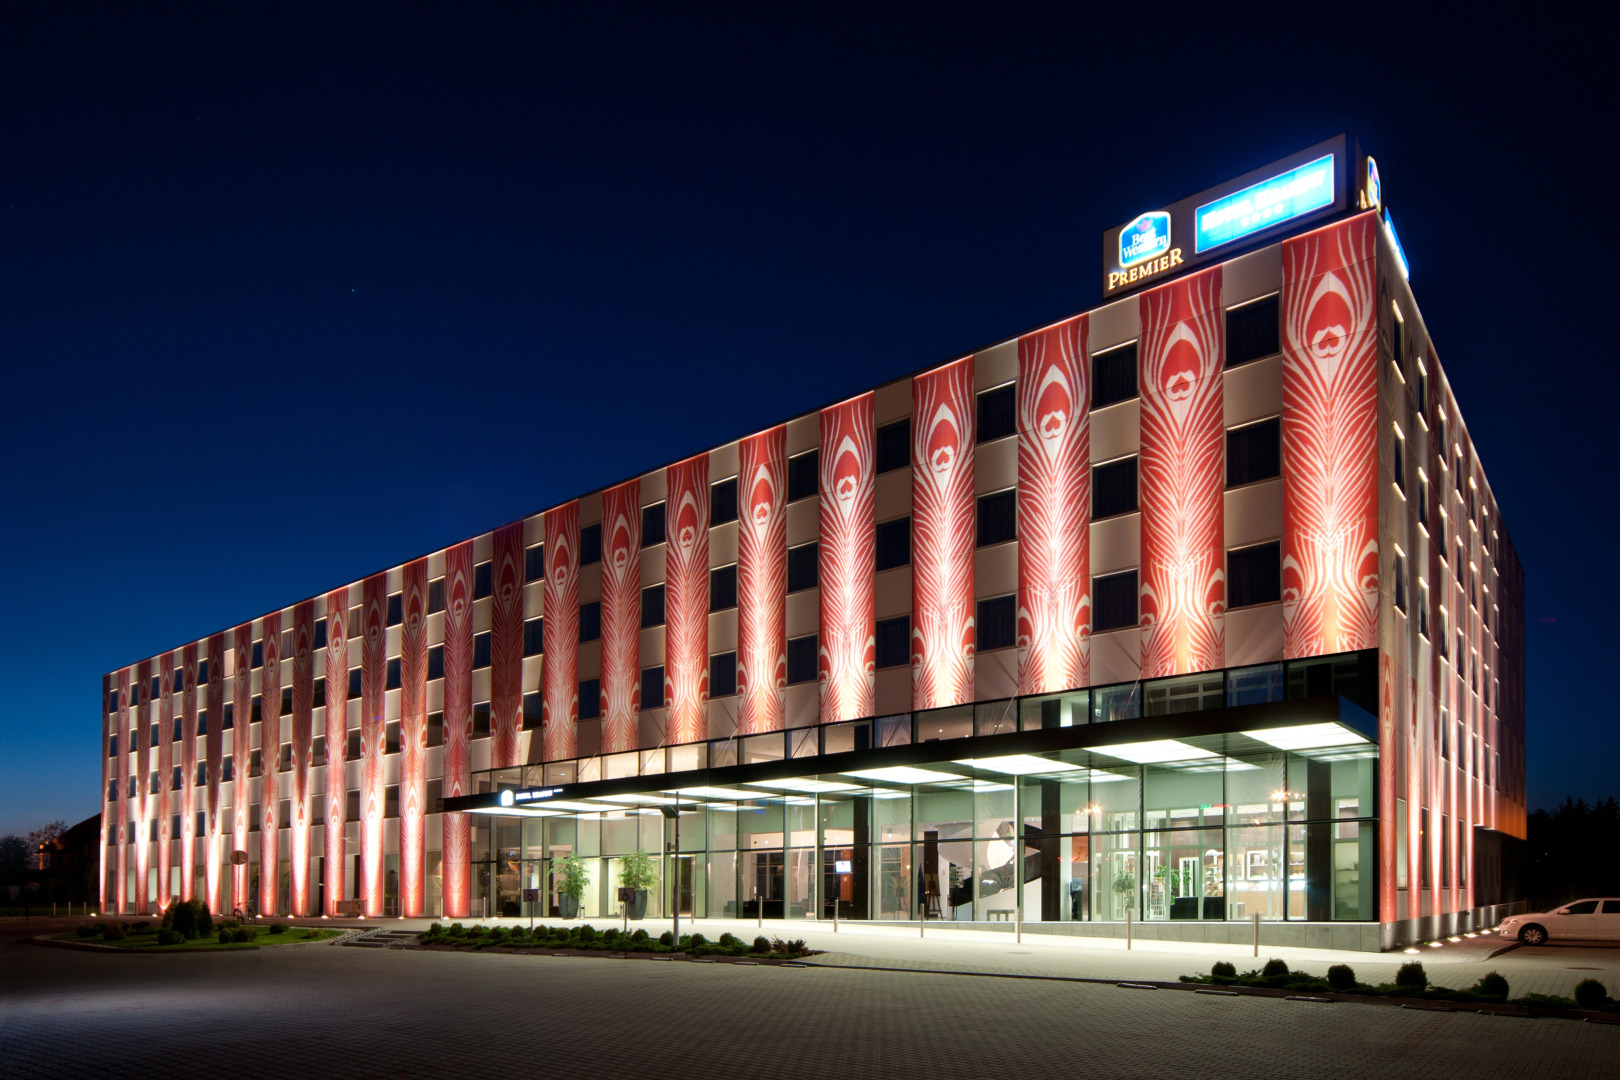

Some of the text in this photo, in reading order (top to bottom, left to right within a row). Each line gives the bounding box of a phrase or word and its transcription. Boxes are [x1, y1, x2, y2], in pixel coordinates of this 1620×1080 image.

[1123, 234, 1167, 259] Western
[1132, 226, 1157, 246] Best
[1107, 247, 1185, 291] PREMIER
